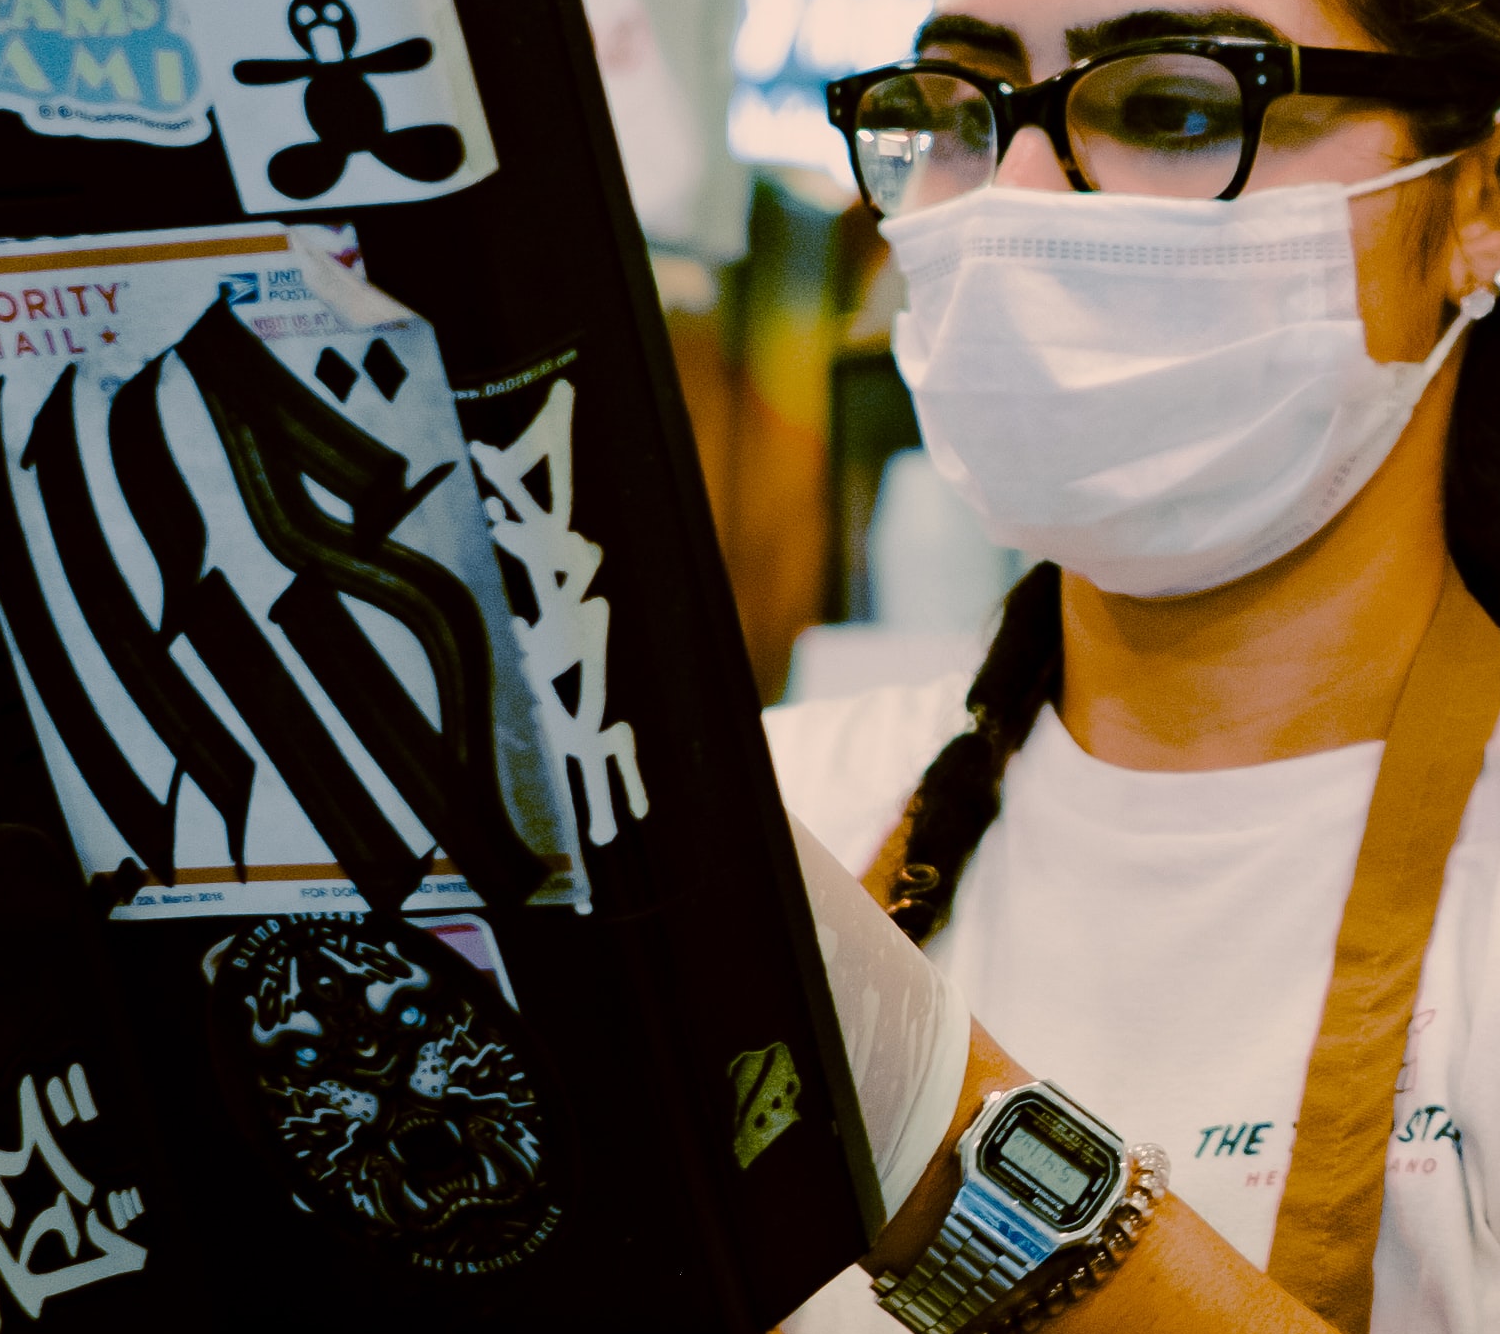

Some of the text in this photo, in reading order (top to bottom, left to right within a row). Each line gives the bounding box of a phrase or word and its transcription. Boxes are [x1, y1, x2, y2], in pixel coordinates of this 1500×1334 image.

[232, 918, 281, 970] BLIND
[1193, 1120, 1274, 1160] THE
[412, 1203, 564, 1275] THE PACIFIC CIRCLE
